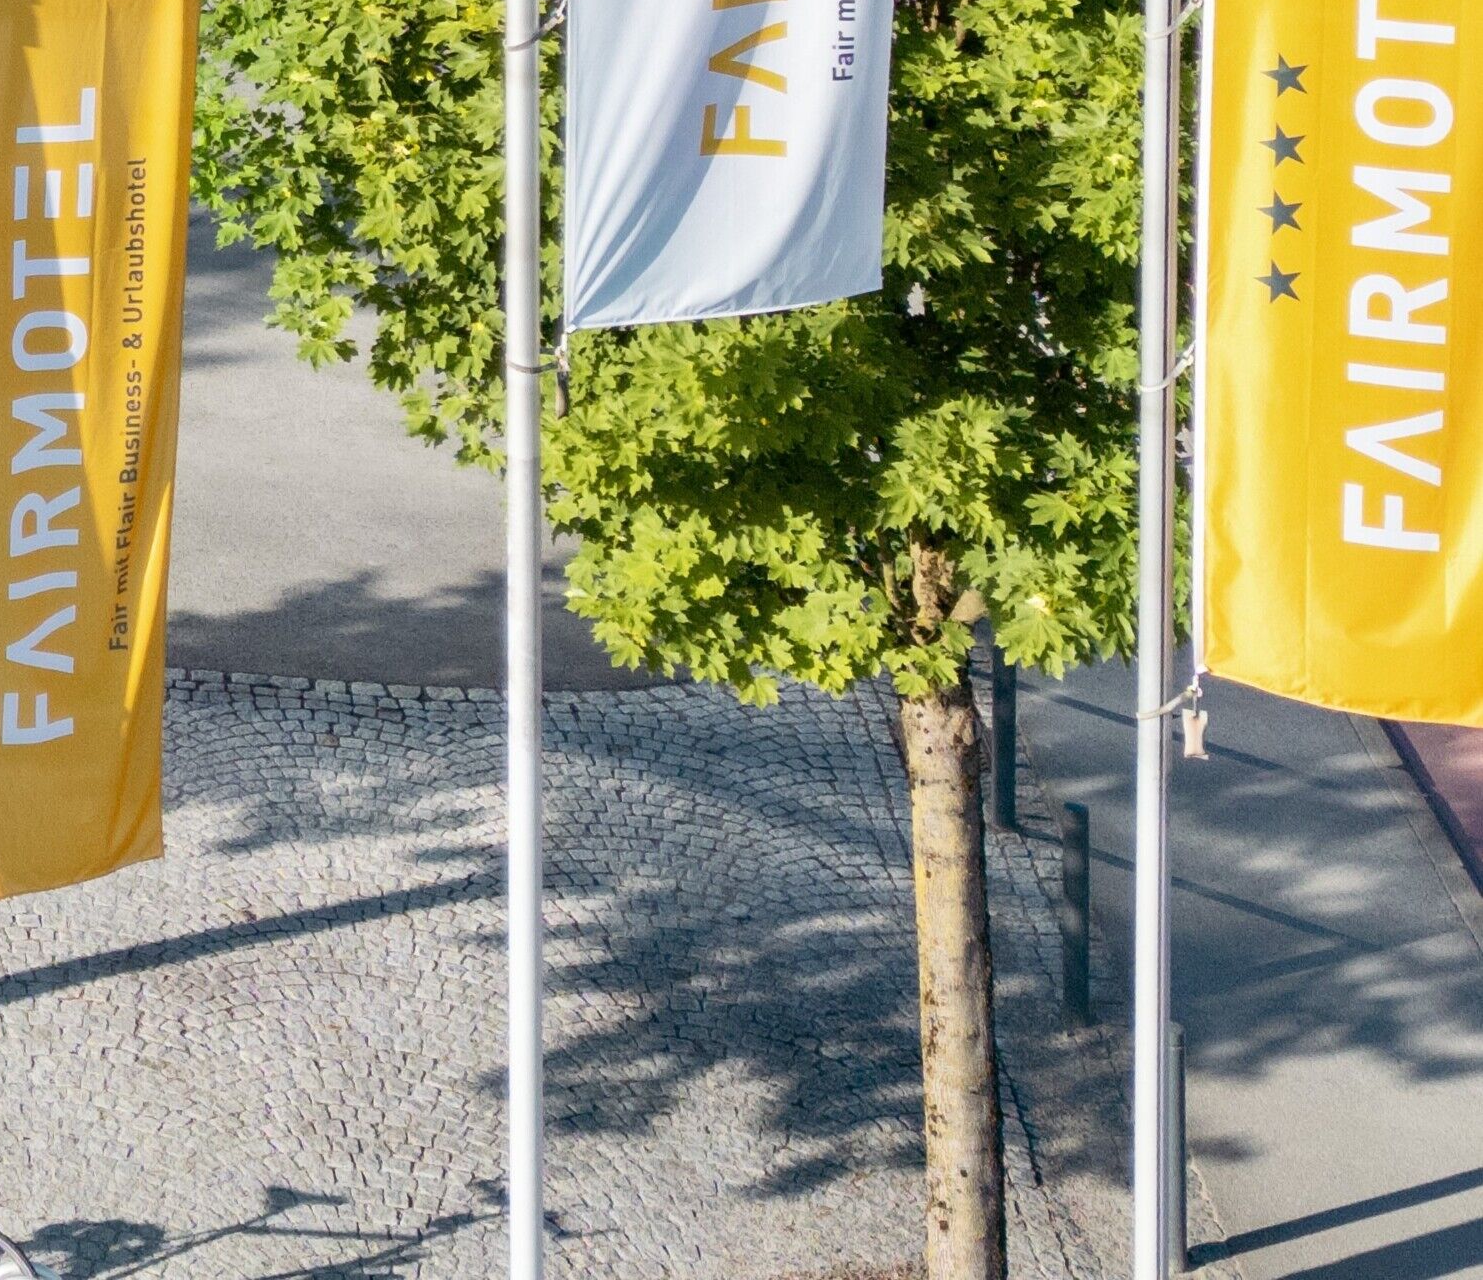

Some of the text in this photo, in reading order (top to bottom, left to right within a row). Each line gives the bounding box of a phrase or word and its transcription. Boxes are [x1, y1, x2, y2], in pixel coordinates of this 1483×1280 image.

[832, 30, 855, 82] Fair
[1, 87, 97, 746] FAIRMOTEL
[109, 157, 147, 651] Fair mit Flair Business- & Urlaubshotel
